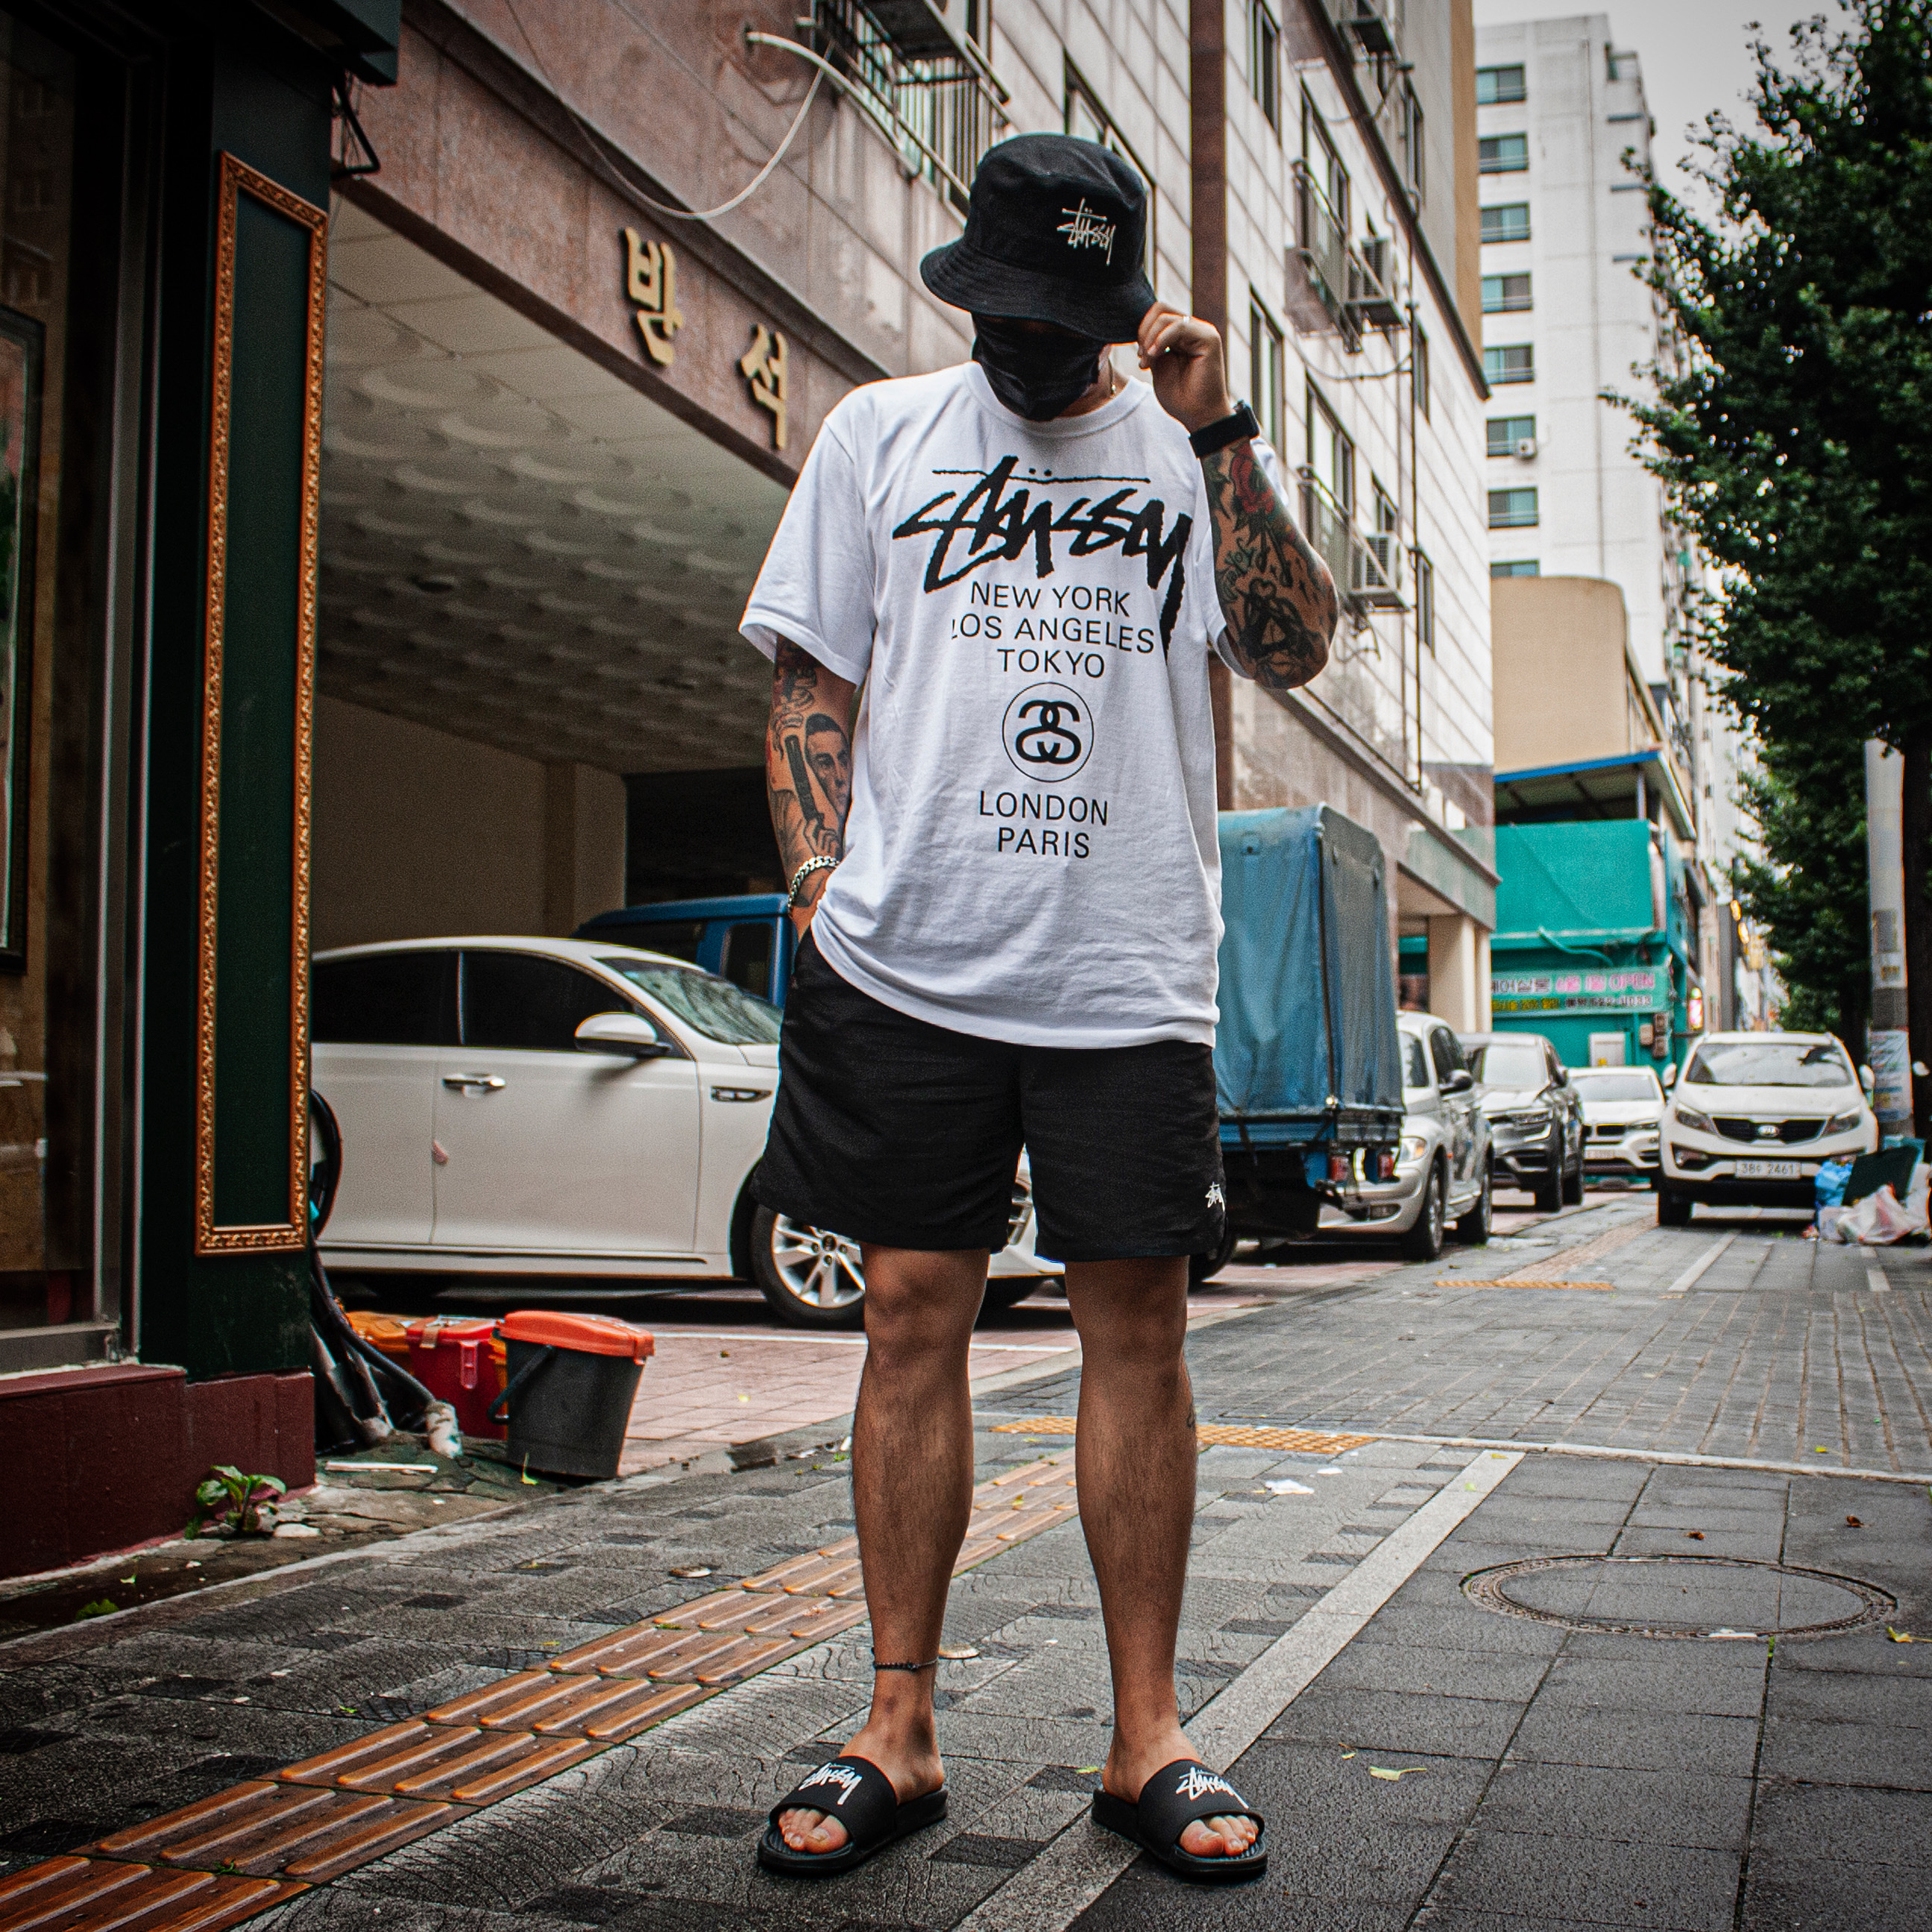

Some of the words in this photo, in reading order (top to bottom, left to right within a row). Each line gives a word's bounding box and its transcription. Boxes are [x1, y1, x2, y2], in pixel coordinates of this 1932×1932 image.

[970, 580, 1042, 610] NEW
[1051, 585, 1130, 617] YORK
[1014, 617, 1154, 654] ANGELES
[997, 648, 1105, 679] TOKYO
[979, 790, 1108, 826] LONDON
[997, 826, 1090, 859] PARIS
